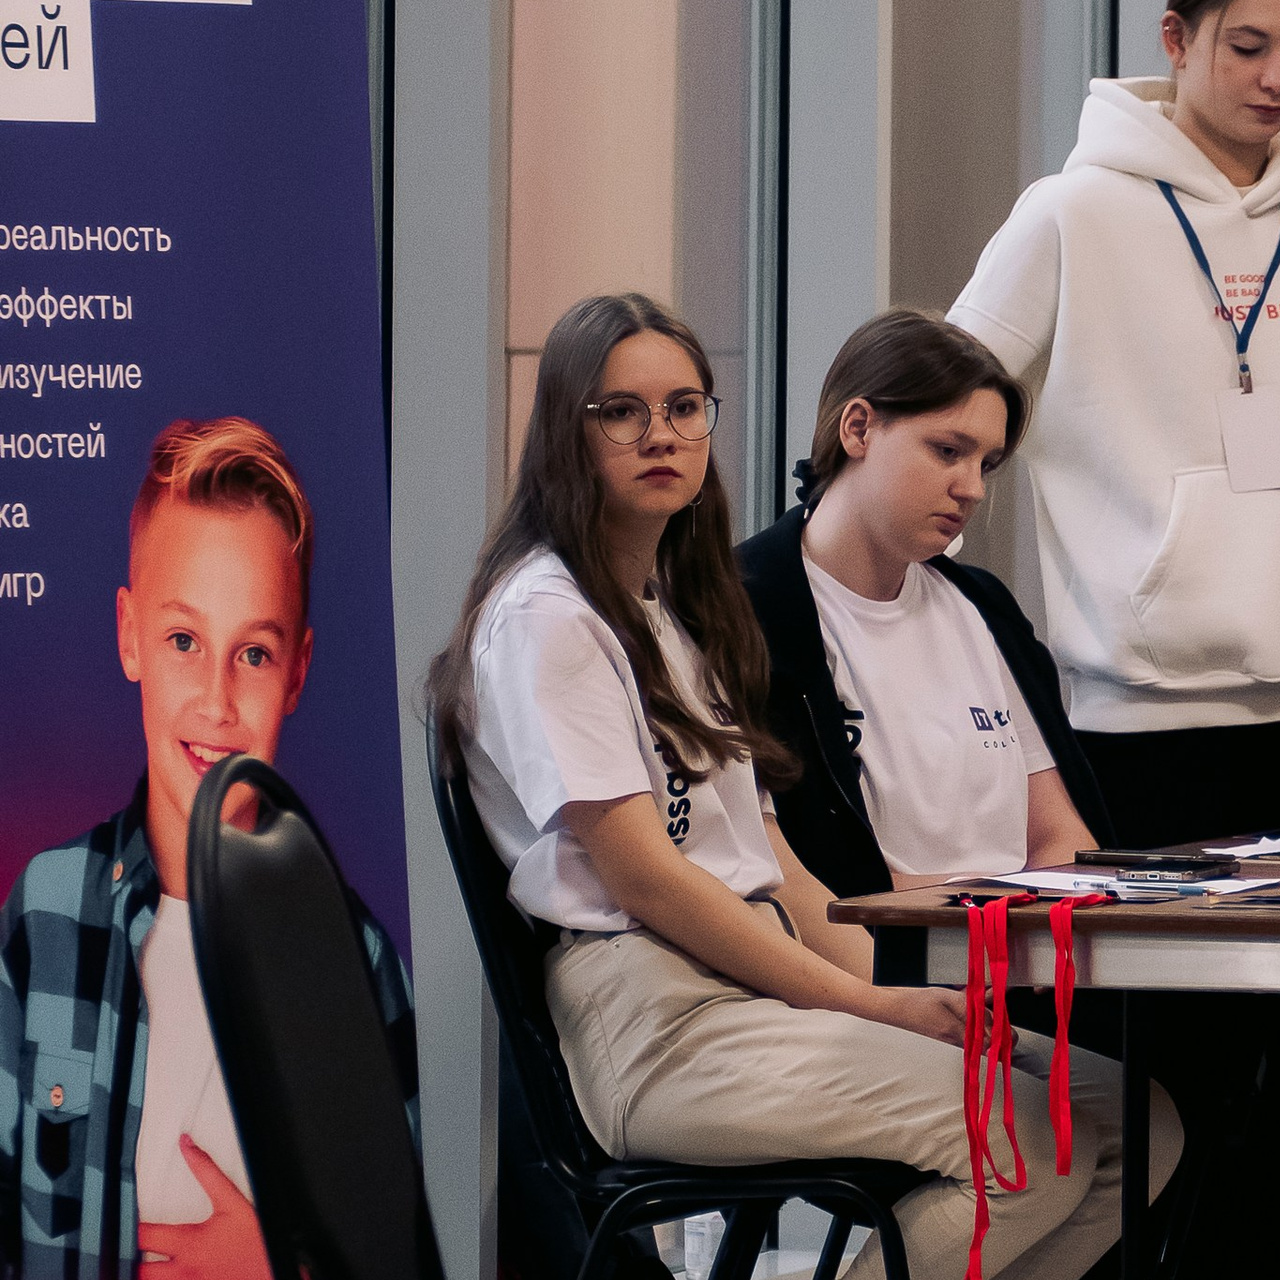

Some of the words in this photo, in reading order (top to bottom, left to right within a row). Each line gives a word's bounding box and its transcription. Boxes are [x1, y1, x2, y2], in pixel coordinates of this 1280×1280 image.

[1, 4, 69, 70] ей
[1224, 275, 1237, 284] BE
[1226, 288, 1239, 298] BE
